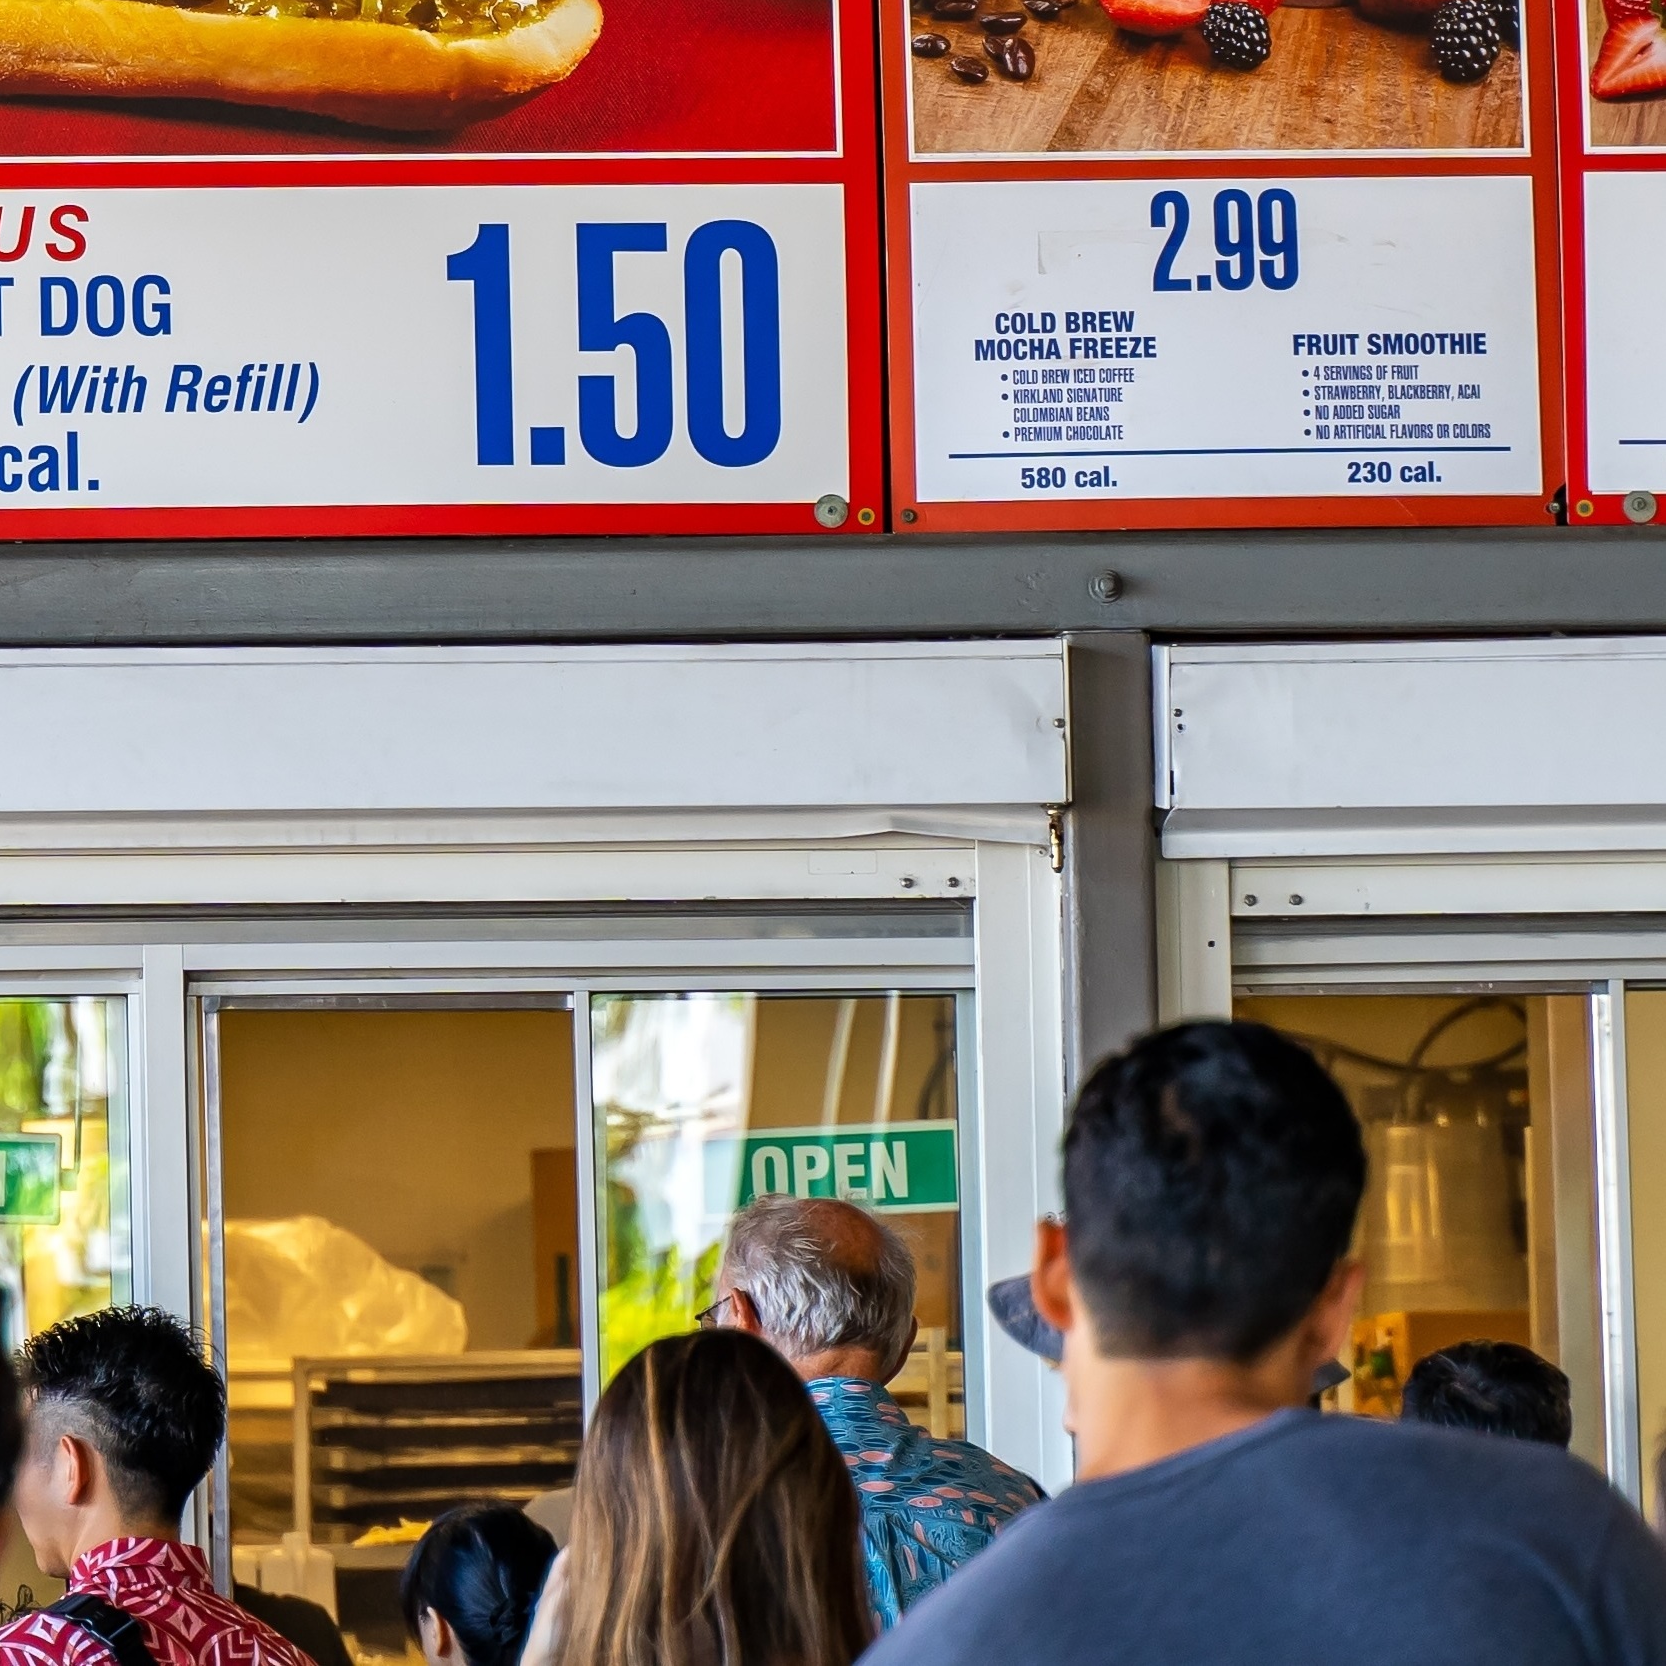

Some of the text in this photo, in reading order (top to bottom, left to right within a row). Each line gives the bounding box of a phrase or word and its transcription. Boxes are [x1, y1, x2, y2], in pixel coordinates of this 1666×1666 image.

[1151, 188, 1298, 291] 2.99
[40, 275, 171, 337] DOG
[995, 311, 1134, 334] COLD BREW
[447, 220, 781, 467] 1.50
[975, 337, 1156, 361] MOCHA FREEZE
[1293, 333, 1487, 355] FRUIT SMOOTHIE
[1013, 368, 1134, 385] COLD BREW ICED COFFEE
[1314, 365, 1418, 380] 4 SERVINGS OF FRUIT
[14, 365, 147, 427] (With
[165, 362, 319, 423] Refill)
[1014, 387, 1123, 403] KIRKLAND SIGNATURE
[1315, 384, 1480, 401] STRAWBERRY, BLACKBERRY, ACAI
[1014, 406, 1109, 423] COLOMBIAN BEANS
[1316, 405, 1400, 420] NO ADDED SUGAR
[1015, 425, 1123, 441] PREMIUM CHOCOLATE
[1316, 424, 1490, 439] NO ARTIFICIAL FLAVORS OR COLORS
[1022, 466, 1117, 488] 580 cal.
[1348, 461, 1441, 483] 230 cal.
[752, 1141, 908, 1199] OPEN
